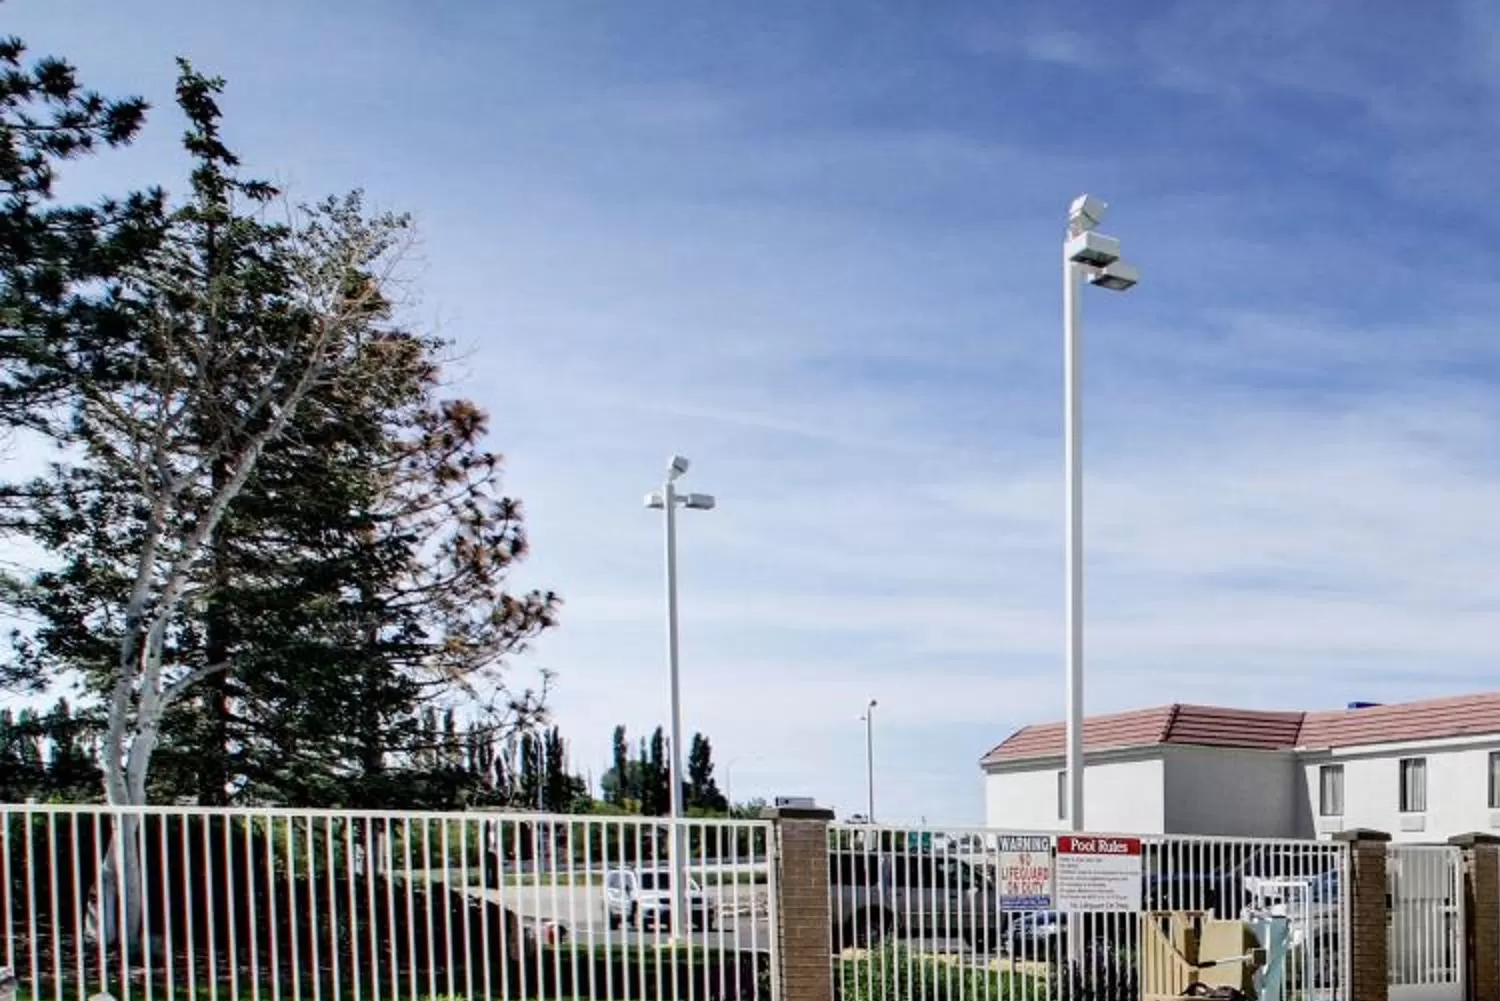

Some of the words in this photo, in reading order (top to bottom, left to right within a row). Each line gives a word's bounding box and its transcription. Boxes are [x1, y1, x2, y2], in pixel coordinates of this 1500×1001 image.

[1000, 838, 1048, 851] WARNING
[1071, 839, 1096, 852] Pool
[1098, 840, 1129, 853] Rules
[1019, 854, 1032, 866] NO
[1001, 867, 1049, 880] LIFEGUARD
[1008, 881, 1020, 894] ON
[1022, 882, 1045, 895] DUTY
